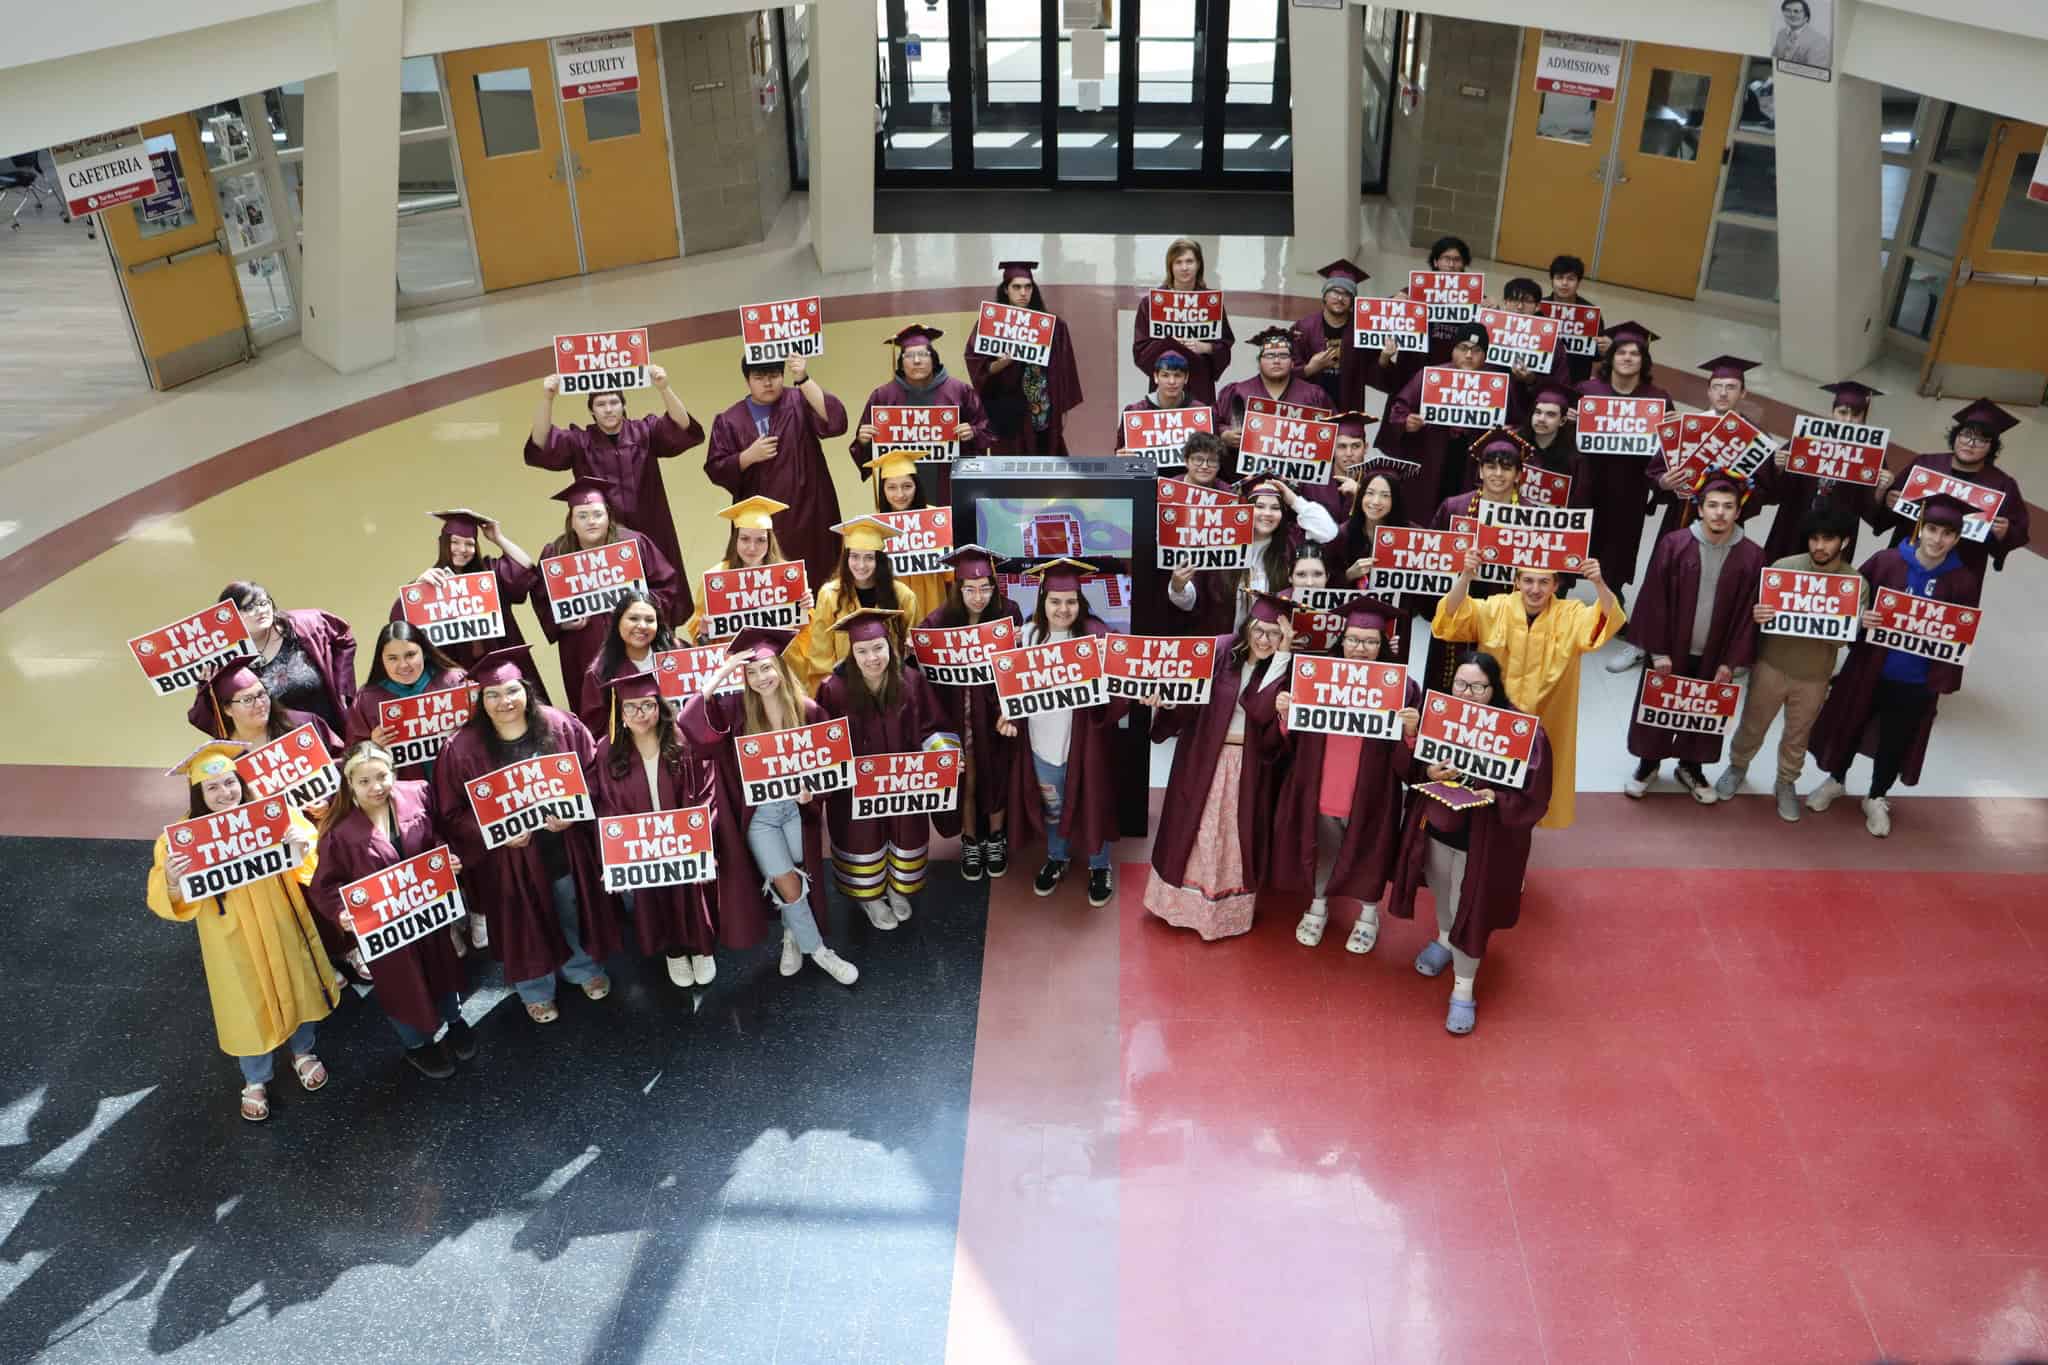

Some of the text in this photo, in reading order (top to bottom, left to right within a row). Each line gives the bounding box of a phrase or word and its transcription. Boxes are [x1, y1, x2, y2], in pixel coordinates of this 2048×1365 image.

[569, 56, 625, 76] SECURITY
[1546, 56, 1610, 76] ADMISSIONS
[68, 156, 142, 188] CAFETERIA
[1434, 275, 1458, 288] I'M
[1174, 294, 1198, 307] I'M
[1423, 288, 1468, 303] TMCC
[771, 303, 797, 321] I'M
[1005, 309, 1030, 326] I'M
[1163, 307, 1208, 321] TMCC
[1380, 302, 1404, 316] I'M
[1550, 305, 1574, 320] I'M
[760, 318, 809, 339] TMCC
[993, 321, 1038, 343] TMCC
[1153, 322, 1217, 338] BOUND!
[1369, 315, 1415, 331] TMCC
[1504, 315, 1532, 332] I'M
[586, 334, 617, 352] I'M
[1492, 328, 1540, 350] TMCC
[574, 350, 631, 370] TMCC
[1488, 346, 1548, 370] OUND!
[563, 365, 643, 392] BOUND!
[1452, 373, 1480, 389] I'M
[1438, 387, 1490, 406] TMCC
[901, 410, 929, 424] I'M
[1424, 406, 1500, 426] BOUND!
[1607, 400, 1635, 416] I'M
[1154, 412, 1182, 428] I'M
[1274, 420, 1306, 440] I'M
[1594, 416, 1647, 432] TMCC
[888, 426, 942, 440] TMCC
[1580, 433, 1657, 453] BOUND!
[1798, 418, 1883, 446] BOUND!
[1259, 435, 1317, 459] TMCC
[1696, 434, 1724, 464] I'M
[1807, 439, 1864, 463] TMCC
[1816, 458, 1848, 476] I'M
[1185, 487, 1218, 506] I'M
[1938, 478, 1974, 502] I'M
[1190, 508, 1222, 525] I'M
[1484, 504, 1586, 530] BOUND!
[1175, 527, 1235, 544] TMCC
[1408, 532, 1441, 551] I'M
[1497, 528, 1566, 551] TMCC
[574, 550, 608, 572] I'M
[1392, 549, 1453, 571] TMCC
[1512, 548, 1548, 566] I'M
[564, 564, 626, 593] TMCC
[738, 568, 772, 589] I'M
[1374, 570, 1463, 593] BOUND
[1794, 575, 1827, 594] I'M
[422, 595, 484, 620] TMCC
[725, 585, 788, 610] TMCC
[1779, 591, 1839, 614] TMCC
[1909, 599, 1946, 621] I'M
[165, 617, 206, 646] I'M
[1892, 612, 1956, 640] TMCC
[159, 629, 230, 668] TMCC
[944, 629, 980, 646] I'M
[1872, 627, 1966, 662] BOUND!
[690, 648, 724, 670] I'M
[1026, 646, 1064, 668] I'M
[1142, 640, 1179, 658] I'M
[1014, 662, 1083, 690] TMCC
[1125, 657, 1193, 678] TMCC
[1331, 663, 1368, 685] I'M
[1005, 678, 1099, 716] BOUND!
[1106, 679, 1205, 701] BOUND!
[1313, 682, 1382, 708] TMCC
[1675, 680, 1708, 697] I'M
[417, 692, 452, 716] I'M
[1660, 692, 1718, 714] TMCC
[403, 708, 468, 737] TMCC
[1294, 706, 1395, 736] BOUND!
[1460, 704, 1499, 731] I'M
[1642, 708, 1728, 733] BOUND!
[774, 729, 813, 753] I'M
[1442, 719, 1510, 756] TMCC
[248, 743, 289, 775] I'M
[761, 746, 832, 776] TMCC
[890, 754, 924, 773] I'M
[1420, 739, 1520, 784] BOUND!
[504, 761, 544, 790] I'M
[749, 762, 847, 802] BOUND!
[874, 771, 938, 792] TMCC
[494, 774, 565, 813] TMCC
[858, 786, 950, 815] BOUND!
[208, 808, 251, 838] I'M
[637, 815, 674, 837] I'M
[196, 824, 273, 865] TMCC
[623, 834, 692, 860] TMCC
[186, 840, 291, 898] BOUND!
[379, 862, 418, 896] I'M
[610, 852, 706, 887] BOUND!
[370, 877, 438, 922] TMCC
[365, 890, 456, 956] BOUND!
